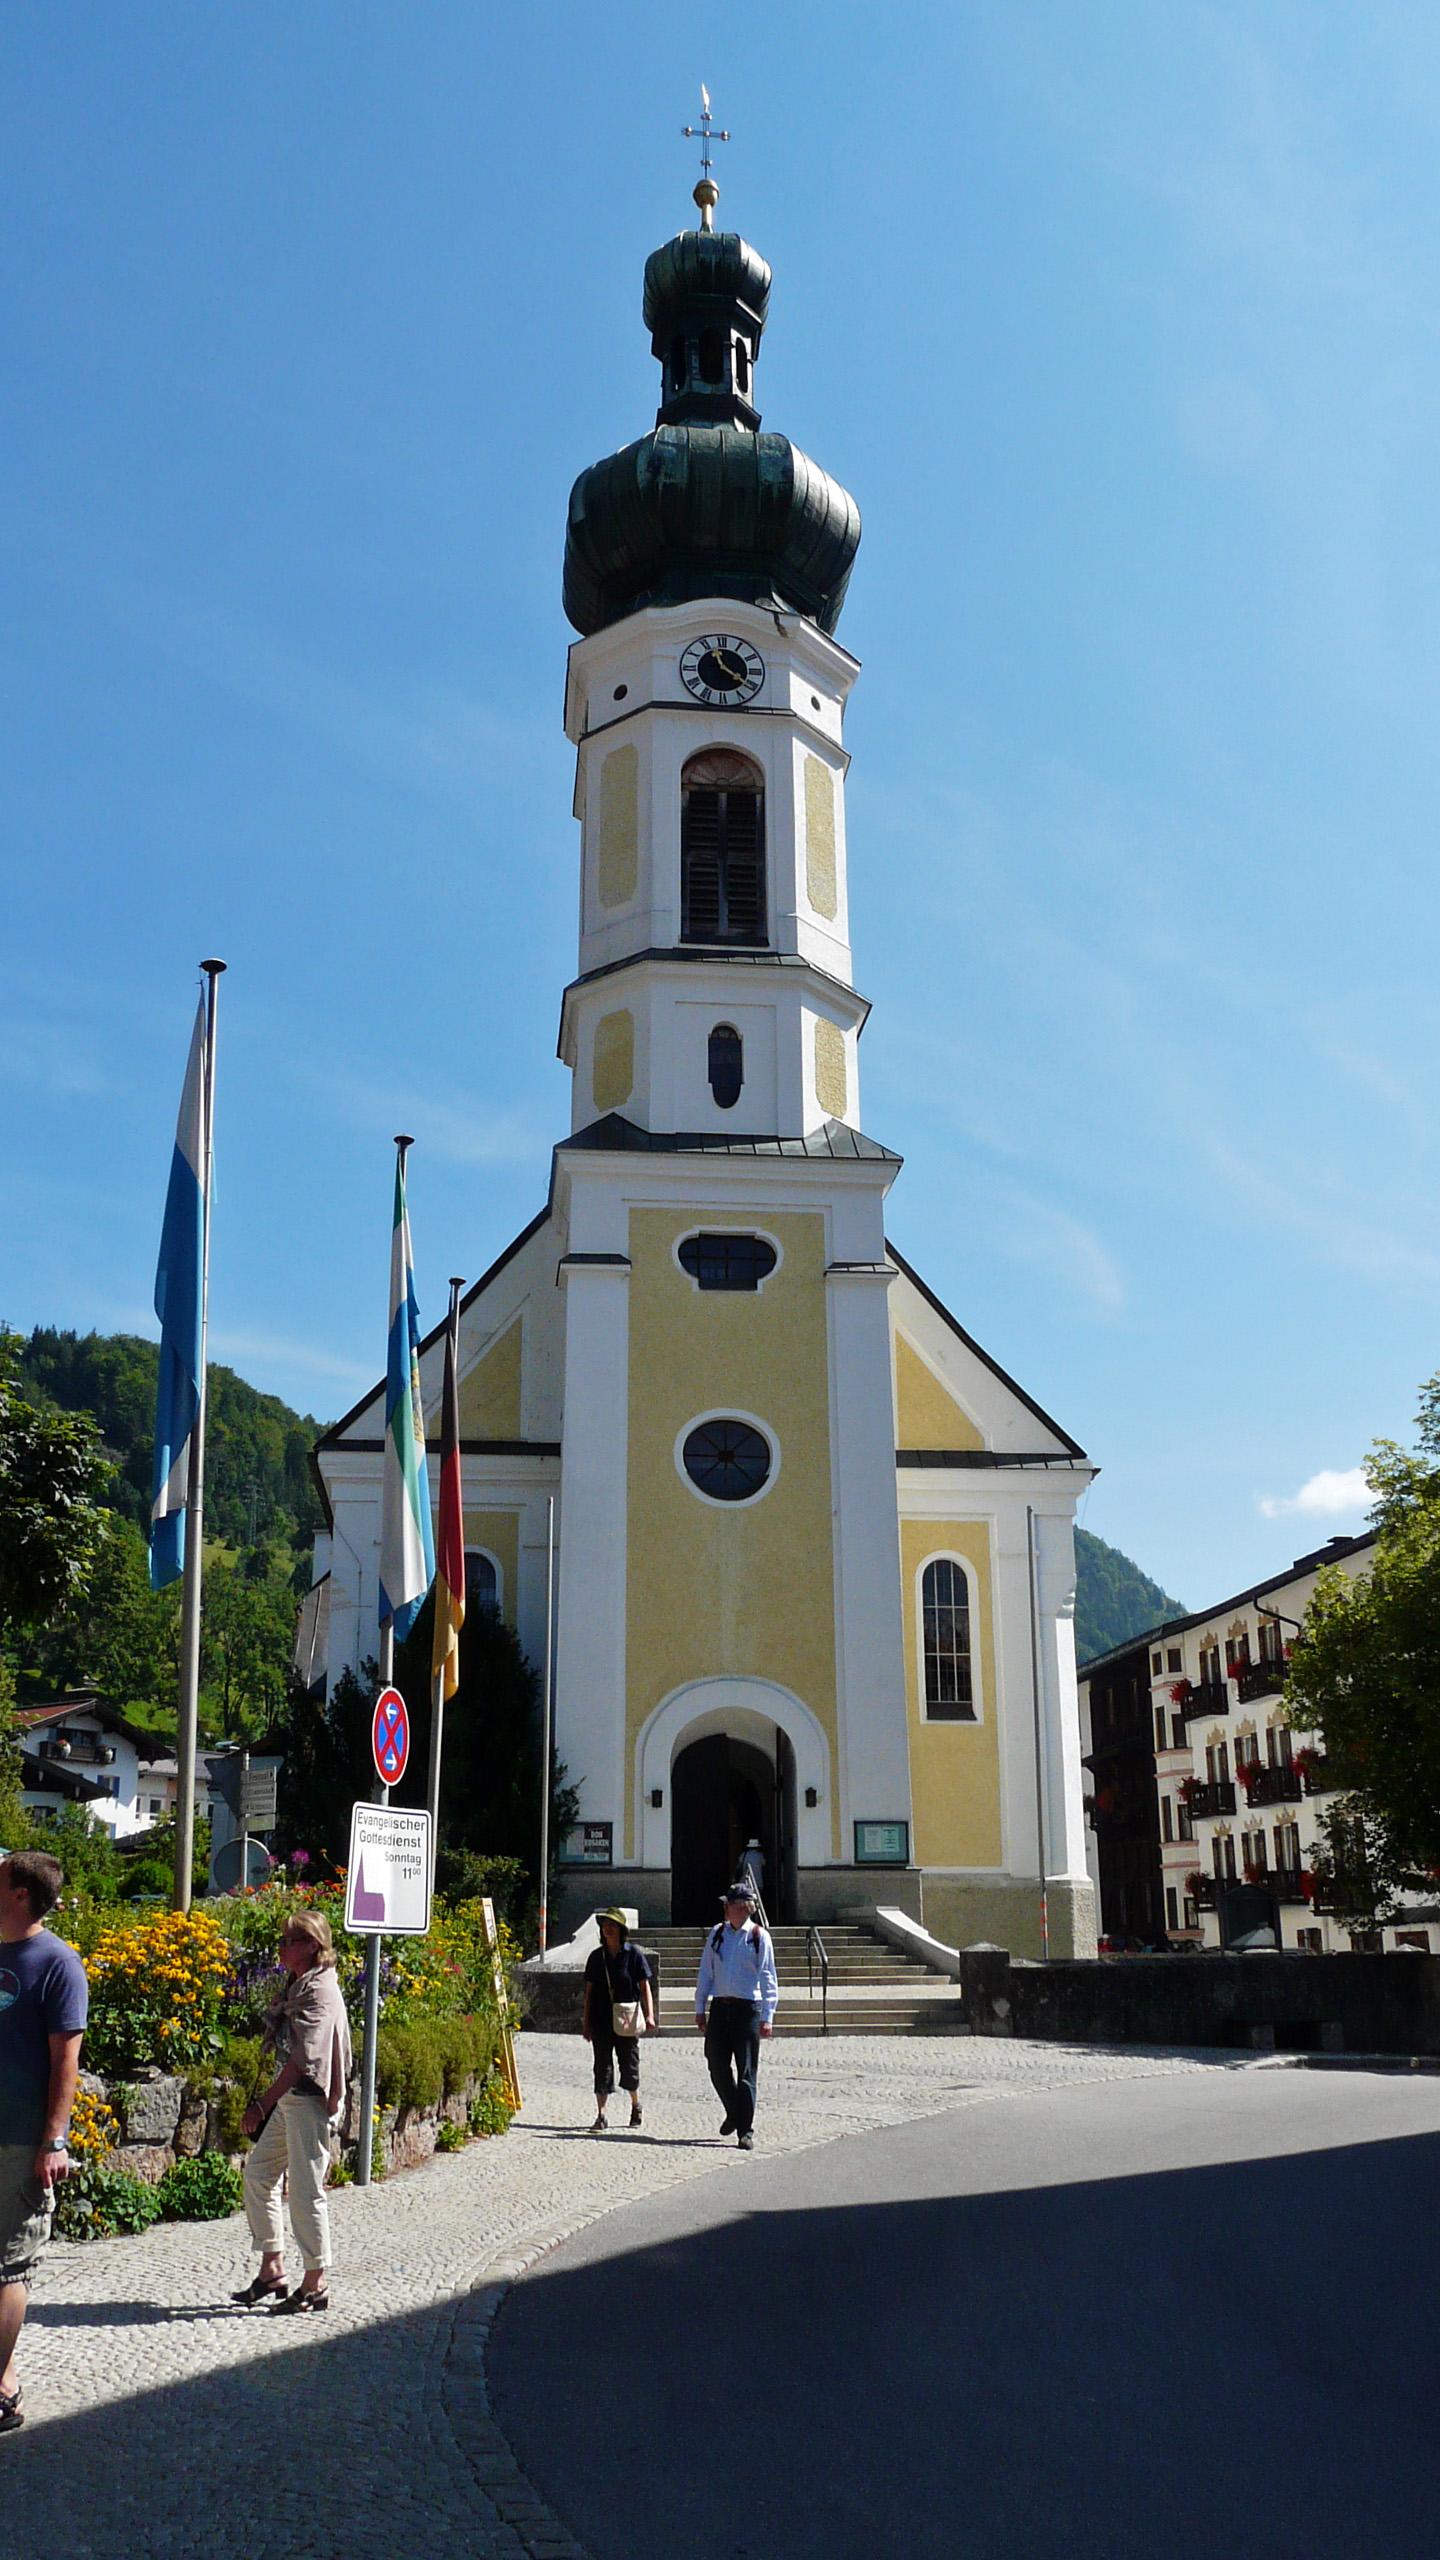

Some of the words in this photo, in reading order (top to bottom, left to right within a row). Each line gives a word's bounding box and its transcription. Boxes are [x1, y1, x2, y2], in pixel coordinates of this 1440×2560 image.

[358, 1811, 425, 1831] Evangelischer
[359, 1830, 421, 1848] Gottesdienst
[384, 1851, 421, 1866] Sonntag
